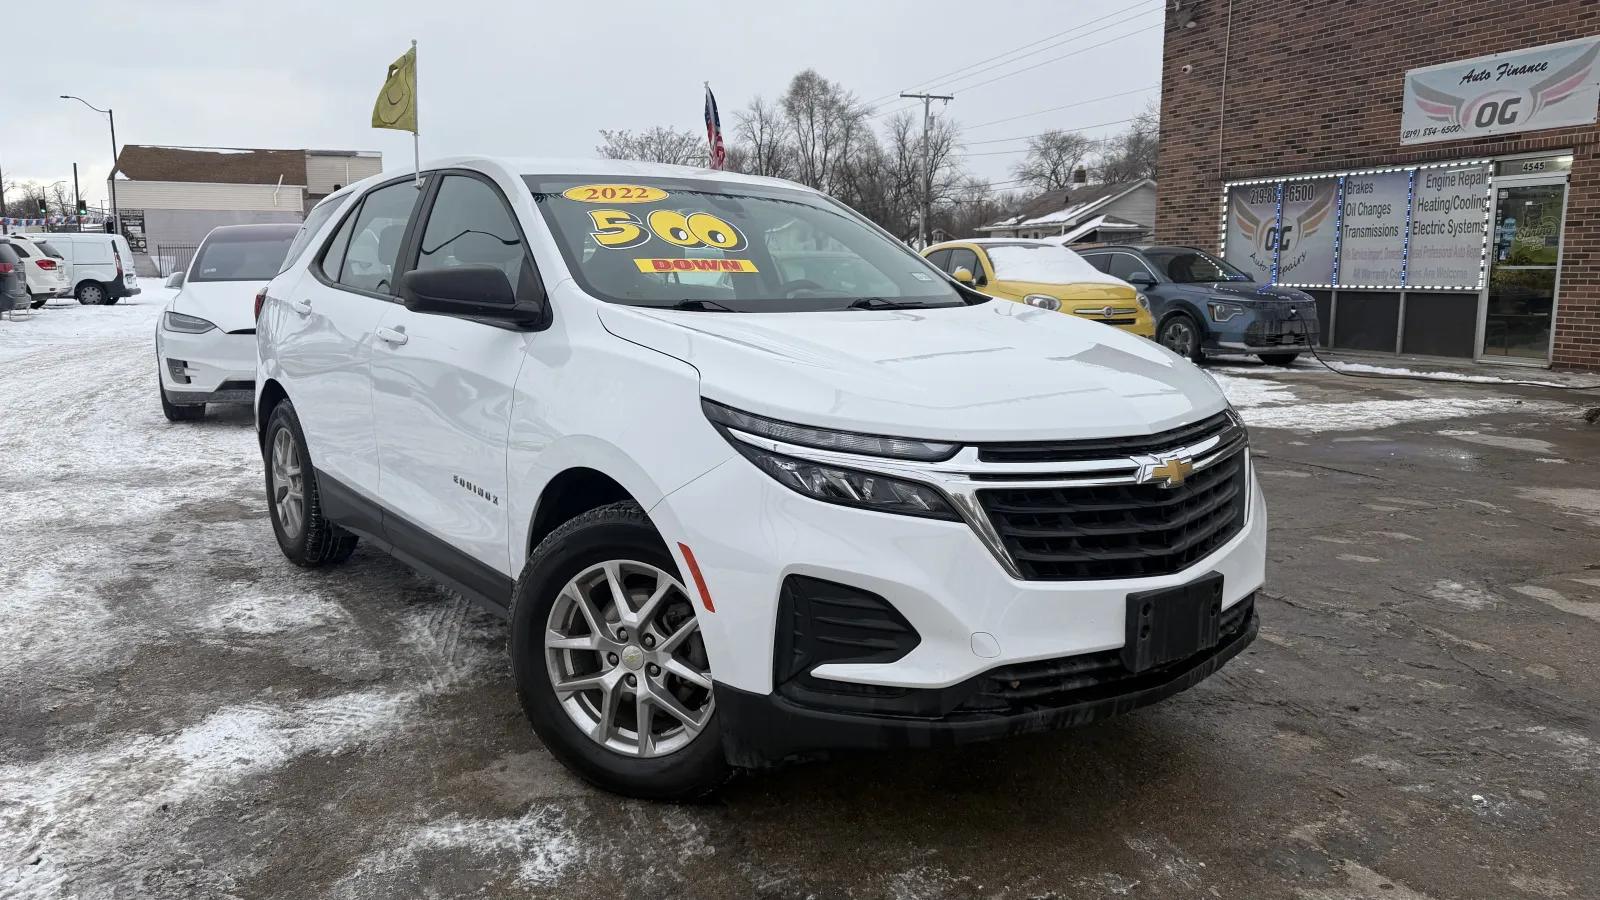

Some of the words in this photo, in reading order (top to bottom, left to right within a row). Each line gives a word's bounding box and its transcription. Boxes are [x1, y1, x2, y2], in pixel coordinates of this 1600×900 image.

[1459, 68, 1492, 85] Auto
[1496, 61, 1549, 81] Finance
[1475, 97, 1522, 128] OG
[1402, 128, 1421, 139] (219)
[1422, 124, 1461, 137] 884-6500
[1523, 162, 1545, 171] 4545
[1347, 181, 1374, 195] Brakes
[1426, 173, 1456, 191] Engine
[1458, 170, 1489, 189] Repair
[585, 187, 649, 200] 2022
[1250, 184, 1315, 205] 219-88-6500
[1345, 202, 1356, 217] Oil
[1358, 202, 1391, 218] Changes
[1417, 194, 1488, 214] Heating/Cooling
[587, 209, 749, 252] 500
[1344, 224, 1399, 238] Transmissions
[1412, 220, 1446, 235] Electric
[1447, 219, 1486, 237] Systems
[1264, 225, 1293, 251] OG
[651, 259, 744, 272] DOWN
[1250, 252, 1267, 272] Auto
[1361, 268, 1388, 282] Warranty
[1423, 267, 1435, 279] Are
[1436, 266, 1468, 279] Welcome
